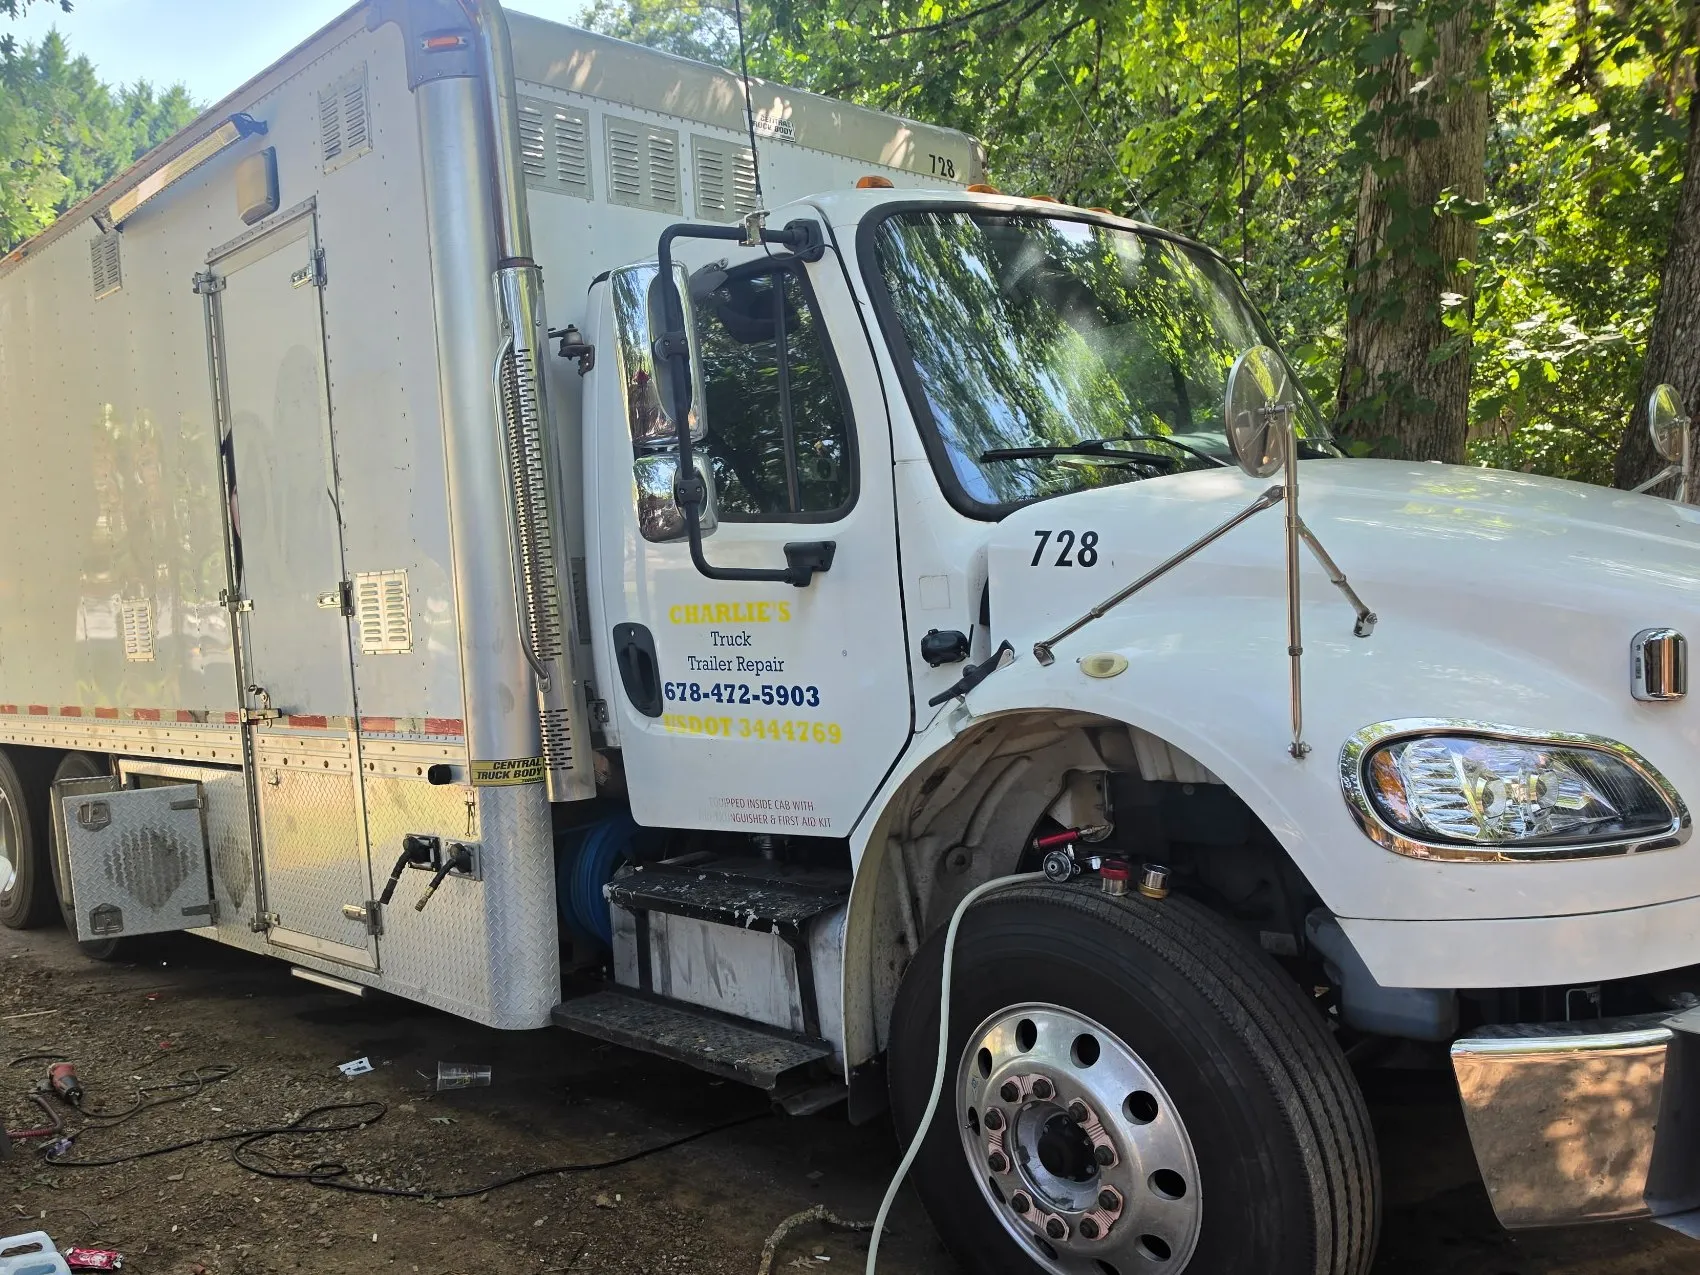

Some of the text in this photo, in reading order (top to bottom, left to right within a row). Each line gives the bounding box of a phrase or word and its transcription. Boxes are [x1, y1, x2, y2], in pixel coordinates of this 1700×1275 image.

[752, 120, 793, 136] RUCK BODY
[928, 153, 955, 179] 728
[1030, 529, 1099, 568] 728
[669, 601, 792, 625] CHARLIE'S
[710, 631, 752, 647] Truck
[687, 655, 785, 677] Trailer Repair
[664, 681, 820, 708] 678-472-5903
[662, 713, 842, 745] USDOT 3444769
[477, 770, 511, 780] TRUCK
[513, 767, 543, 779] BODY
[493, 758, 542, 770] CENTRAL
[746, 798, 773, 810] INSIDE
[774, 800, 791, 811] CAB
[792, 800, 814, 812] WITH
[770, 815, 776, 825] &
[778, 815, 800, 827] FIRST
[801, 816, 816, 828] AID
[818, 816, 832, 828] KIT
